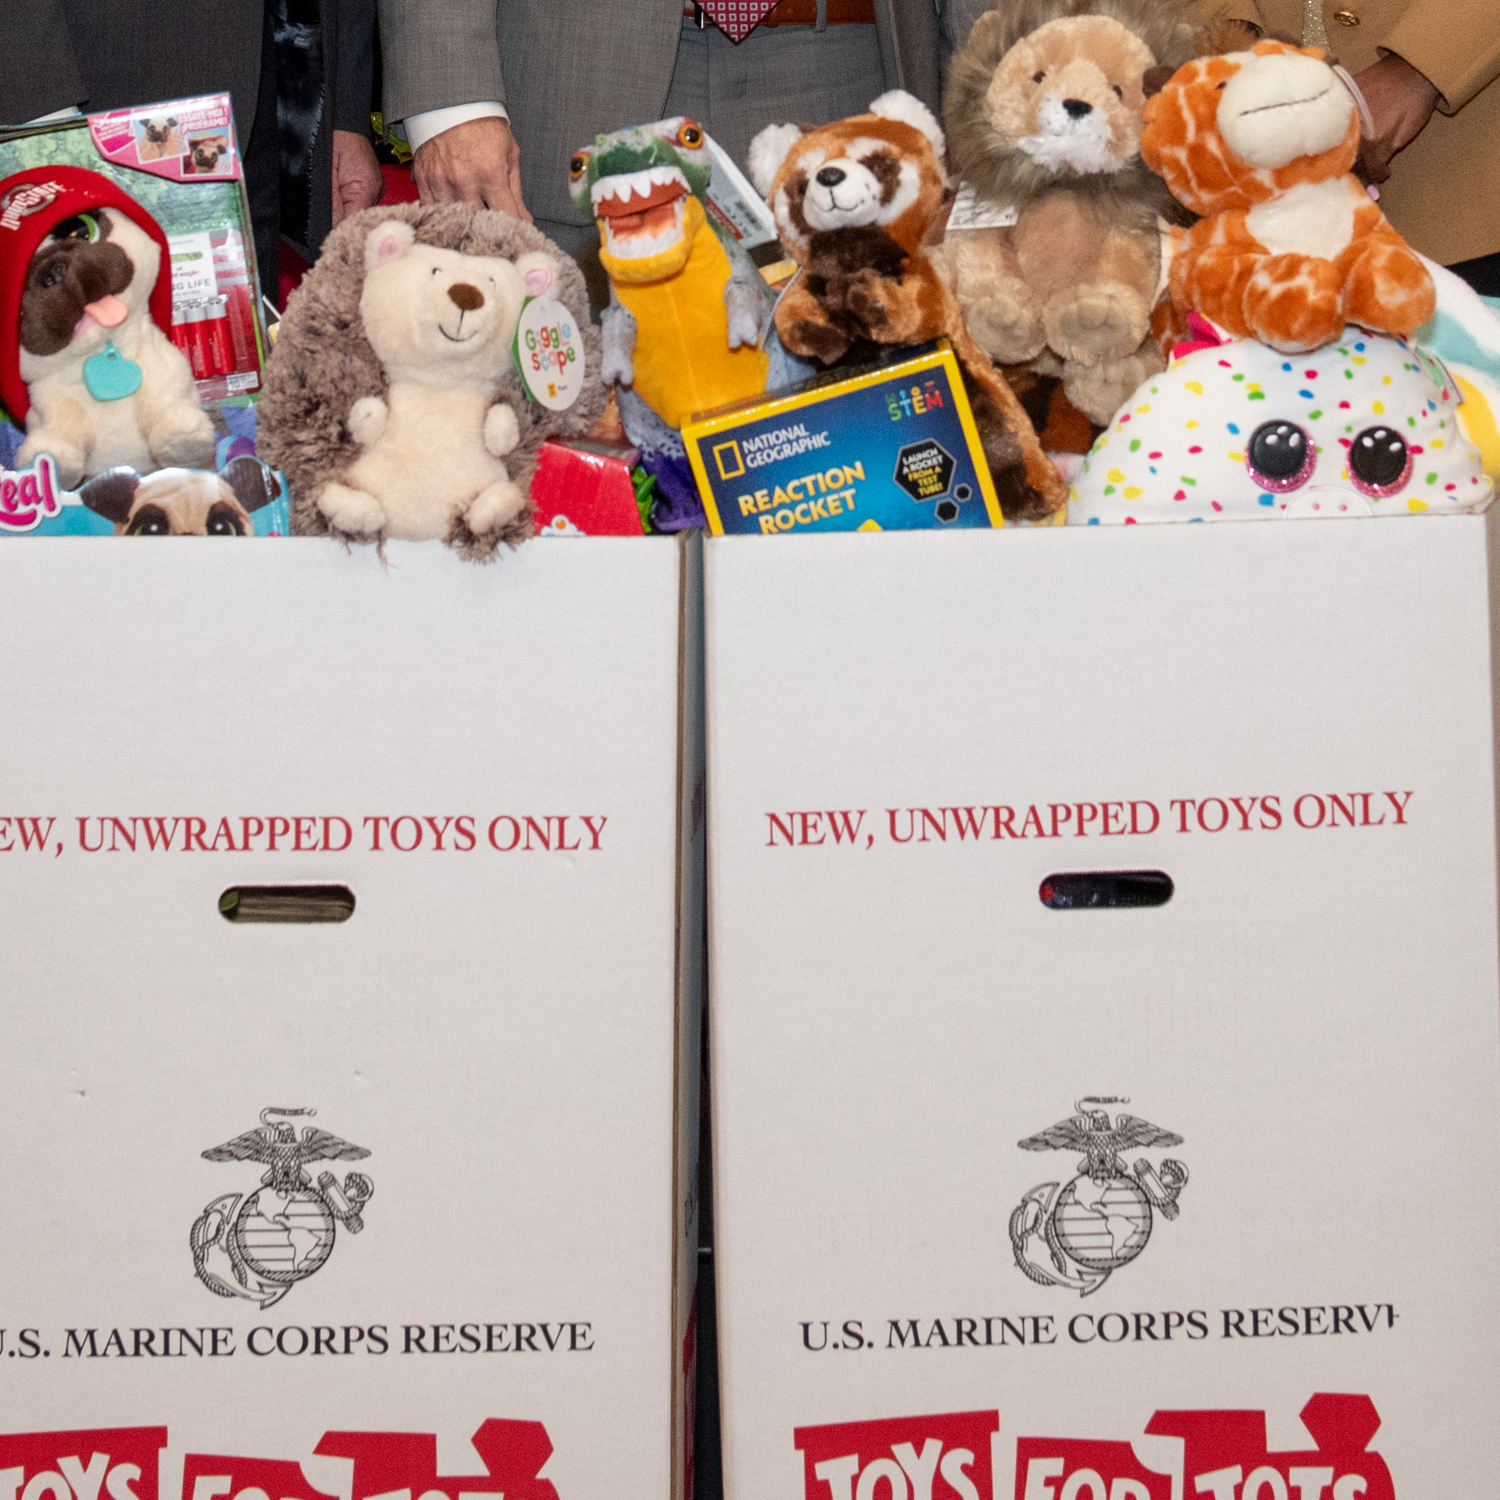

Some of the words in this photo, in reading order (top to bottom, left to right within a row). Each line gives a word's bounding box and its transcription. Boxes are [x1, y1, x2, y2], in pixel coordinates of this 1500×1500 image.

[188, 278, 211, 289] LIFE
[888, 385, 943, 421] STEM
[742, 423, 809, 453] NATIONAL
[745, 431, 832, 469] GEOGRAPHIC
[902, 448, 938, 466] LAUNCH
[908, 467, 934, 482] FROM
[909, 455, 943, 472] ROCKET
[737, 461, 866, 517] REACTION
[917, 474, 938, 487] TEST
[918, 482, 943, 497] TUBE!
[758, 488, 856, 534] ROCKET
[76, 816, 353, 853] UNWRAPPED
[362, 815, 477, 852] TOYS
[486, 815, 608, 852] ONLY
[765, 811, 875, 850] NEW,
[887, 801, 1161, 844] UNWRAPPED
[1170, 795, 1283, 832] TOYS
[1292, 791, 1413, 828] ONLY
[61, 1326, 236, 1358] MARINE
[245, 1325, 390, 1357] CORPS
[400, 1322, 595, 1354] RESERVE
[798, 1320, 874, 1351] U.S.
[885, 1316, 1059, 1349] MARINE
[1068, 1310, 1209, 1344] CORPS
[814, 1437, 975, 1500] TOYS
